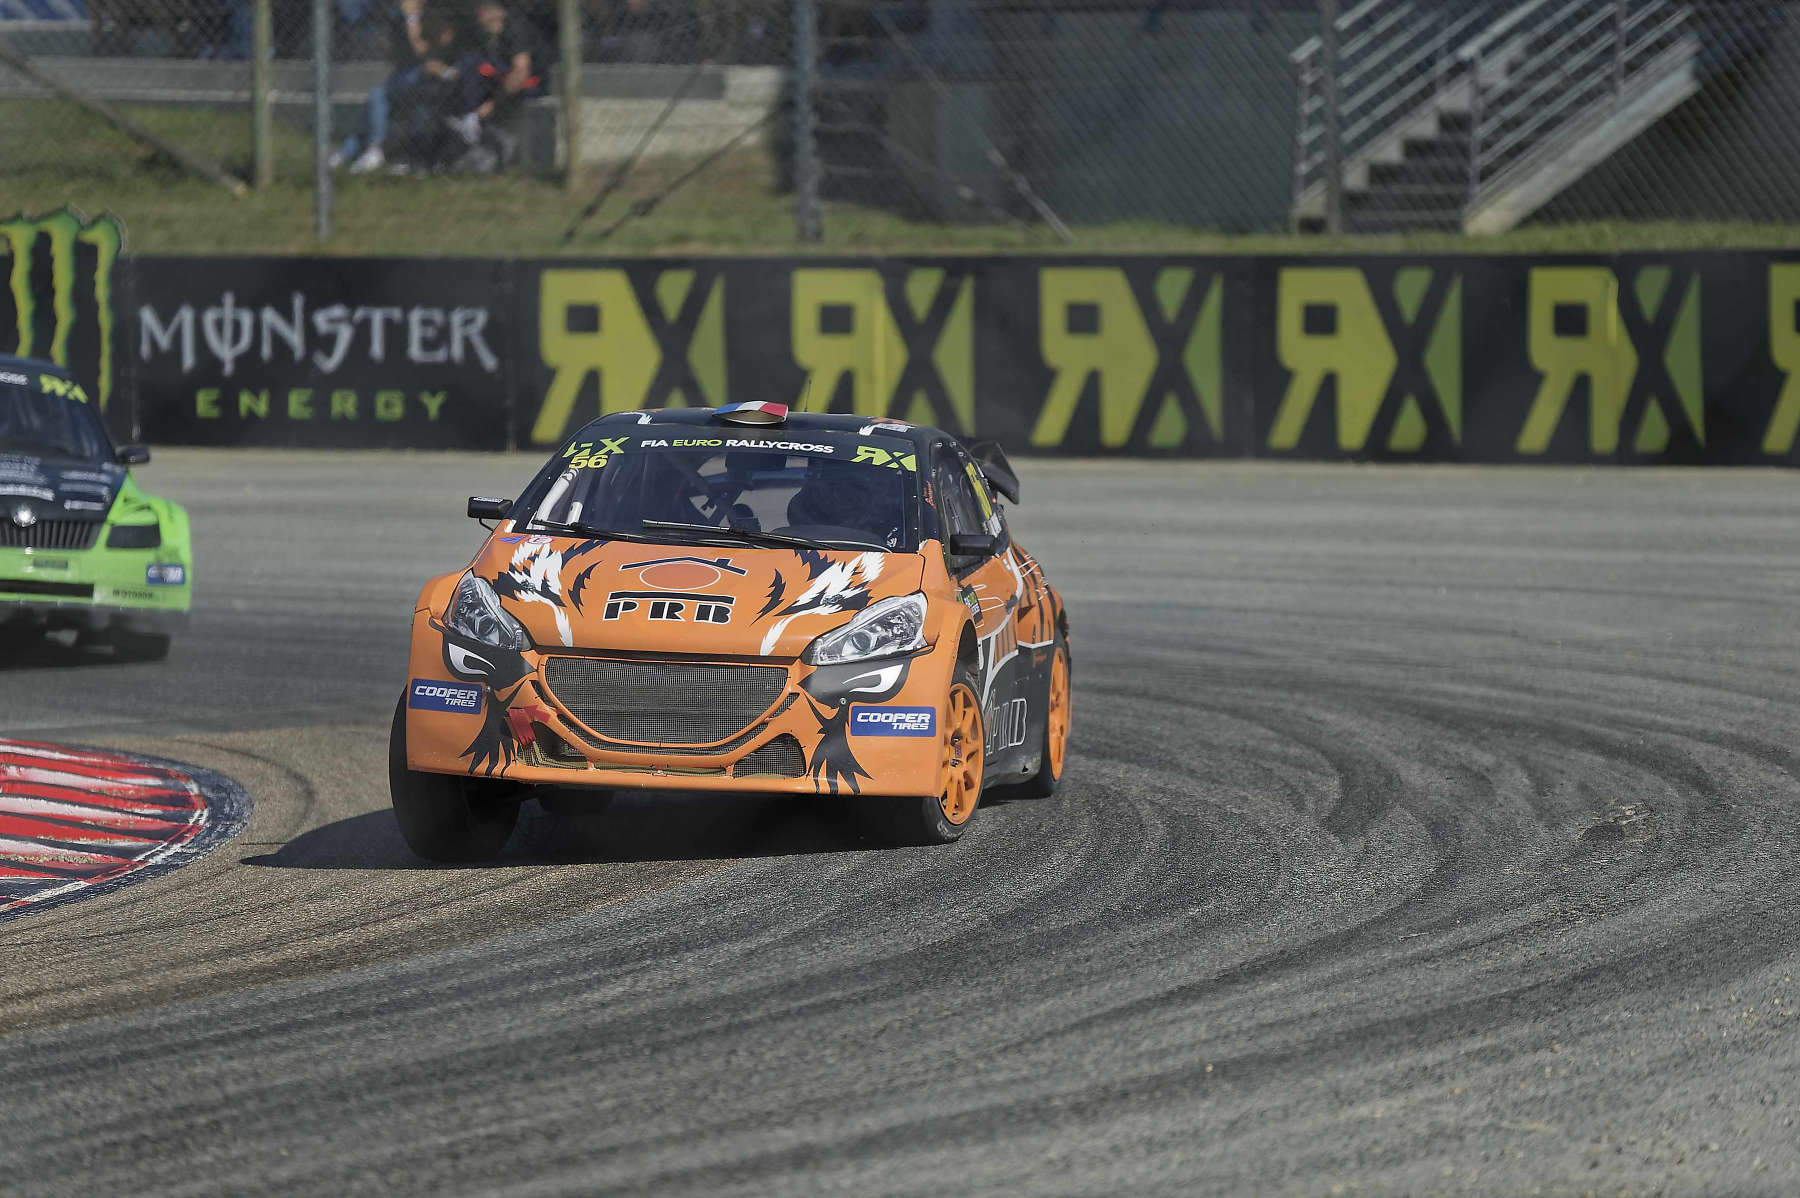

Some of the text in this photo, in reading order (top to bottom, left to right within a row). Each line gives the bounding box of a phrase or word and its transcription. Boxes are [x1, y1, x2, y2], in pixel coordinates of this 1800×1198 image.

[138, 291, 498, 376] MONSTER
[1030, 266, 1224, 447] RX
[1267, 266, 1463, 451] RX
[1516, 266, 1705, 454] RX
[195, 388, 448, 421] ENERGY
[640, 439, 835, 454] FIA EURO RALLYCROSS
[850, 445, 917, 472] RX
[568, 454, 609, 470] 56
[602, 600, 732, 624] PRB
[414, 685, 478, 700] COOPER
[444, 697, 476, 707] TIRES
[856, 712, 931, 723] COOPER
[891, 722, 929, 731] TIRES
